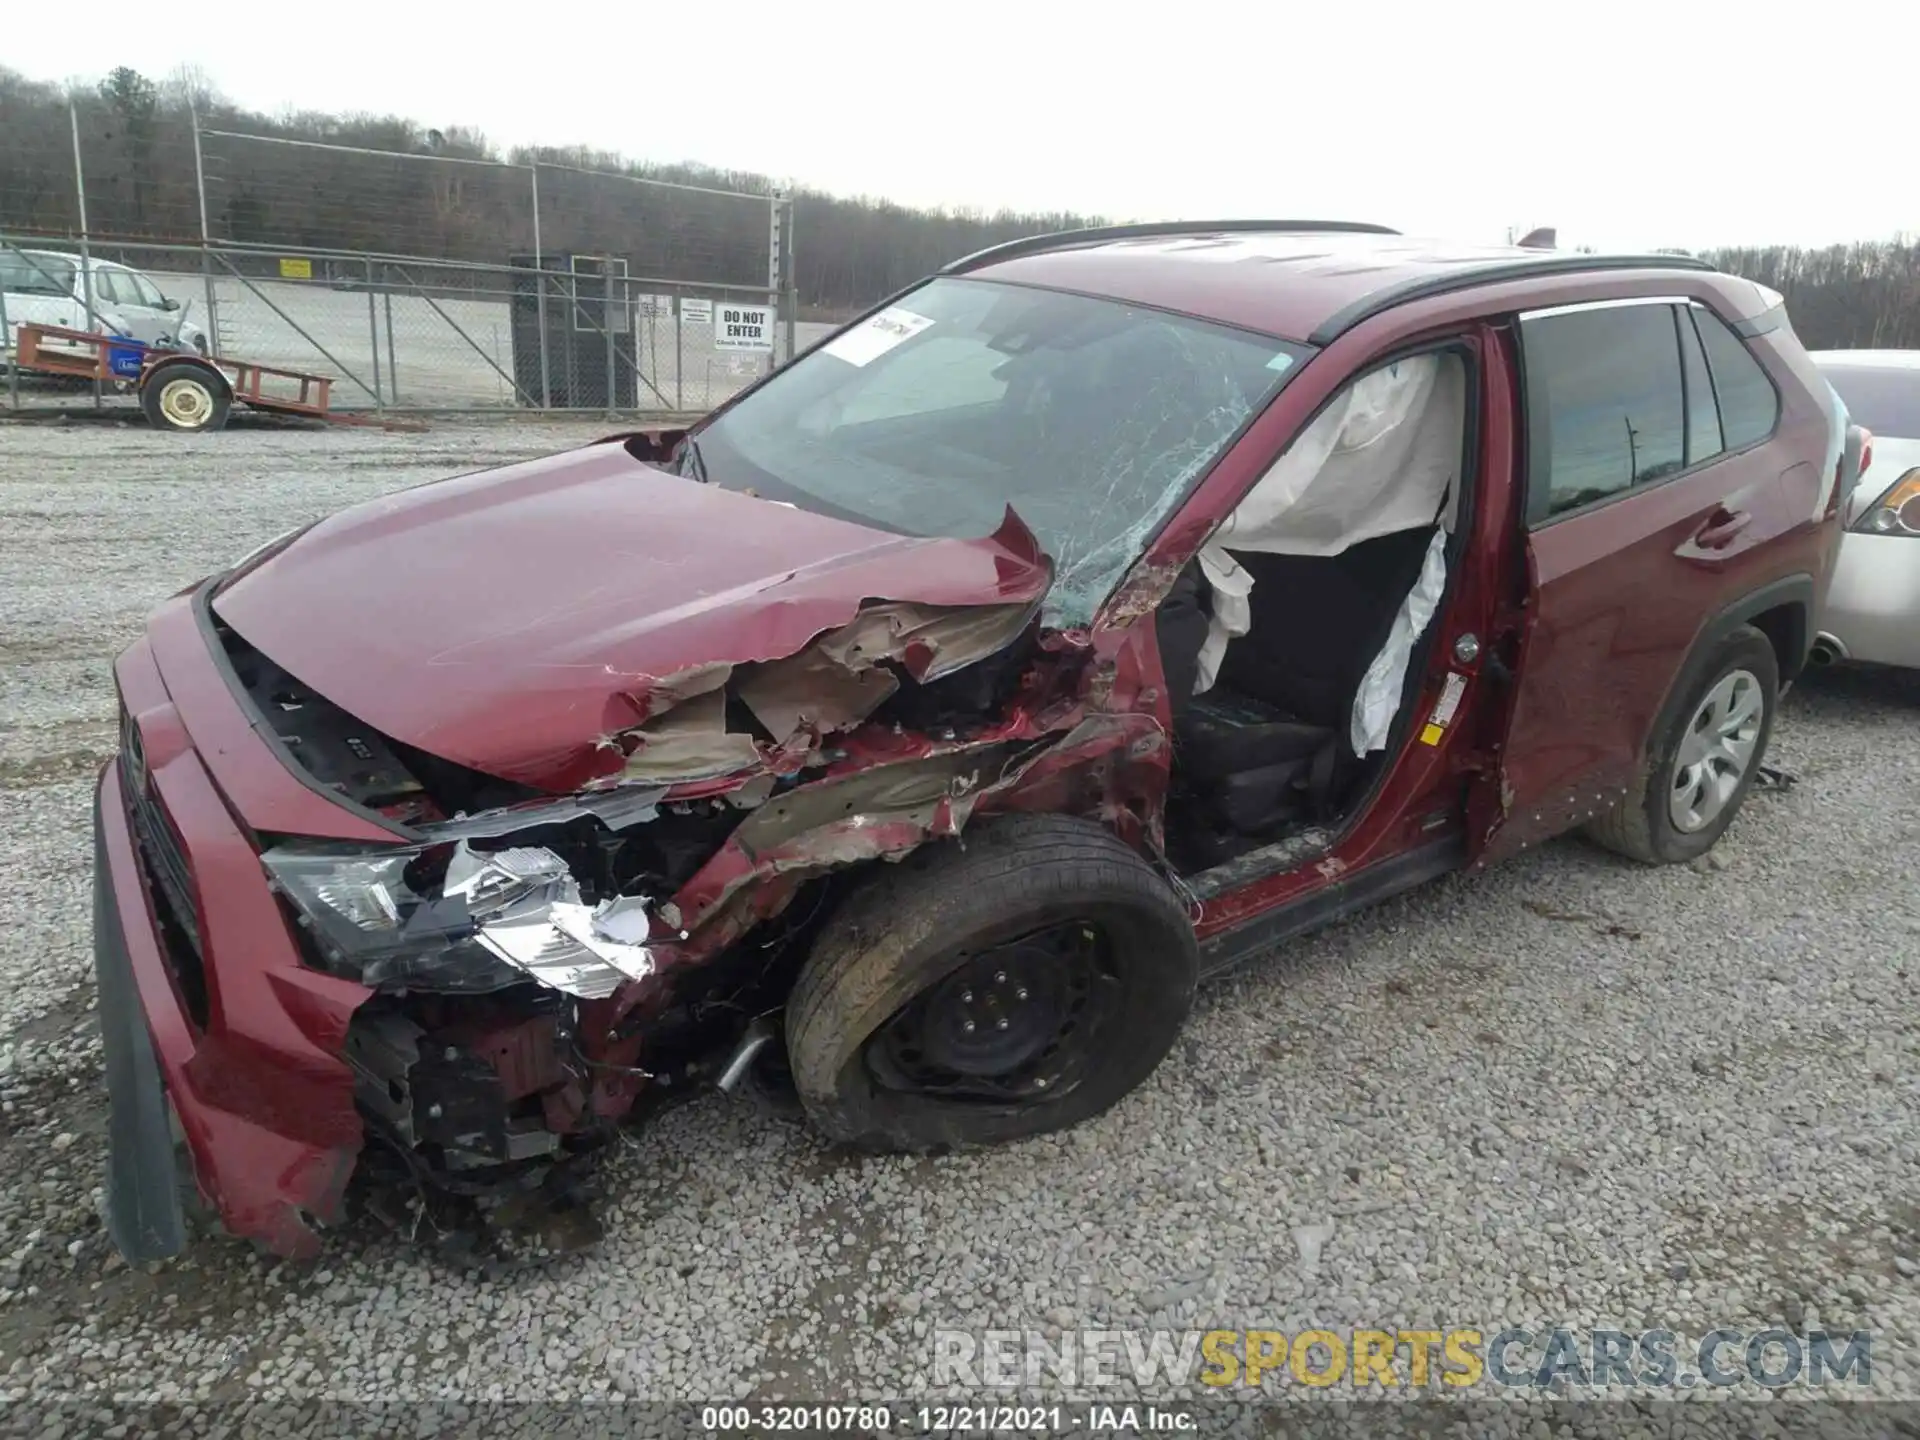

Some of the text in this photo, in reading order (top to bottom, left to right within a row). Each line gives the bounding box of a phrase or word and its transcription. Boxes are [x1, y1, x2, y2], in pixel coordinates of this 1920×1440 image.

[724, 310, 765, 324] DO NOT
[728, 325, 761, 338] ENTER
